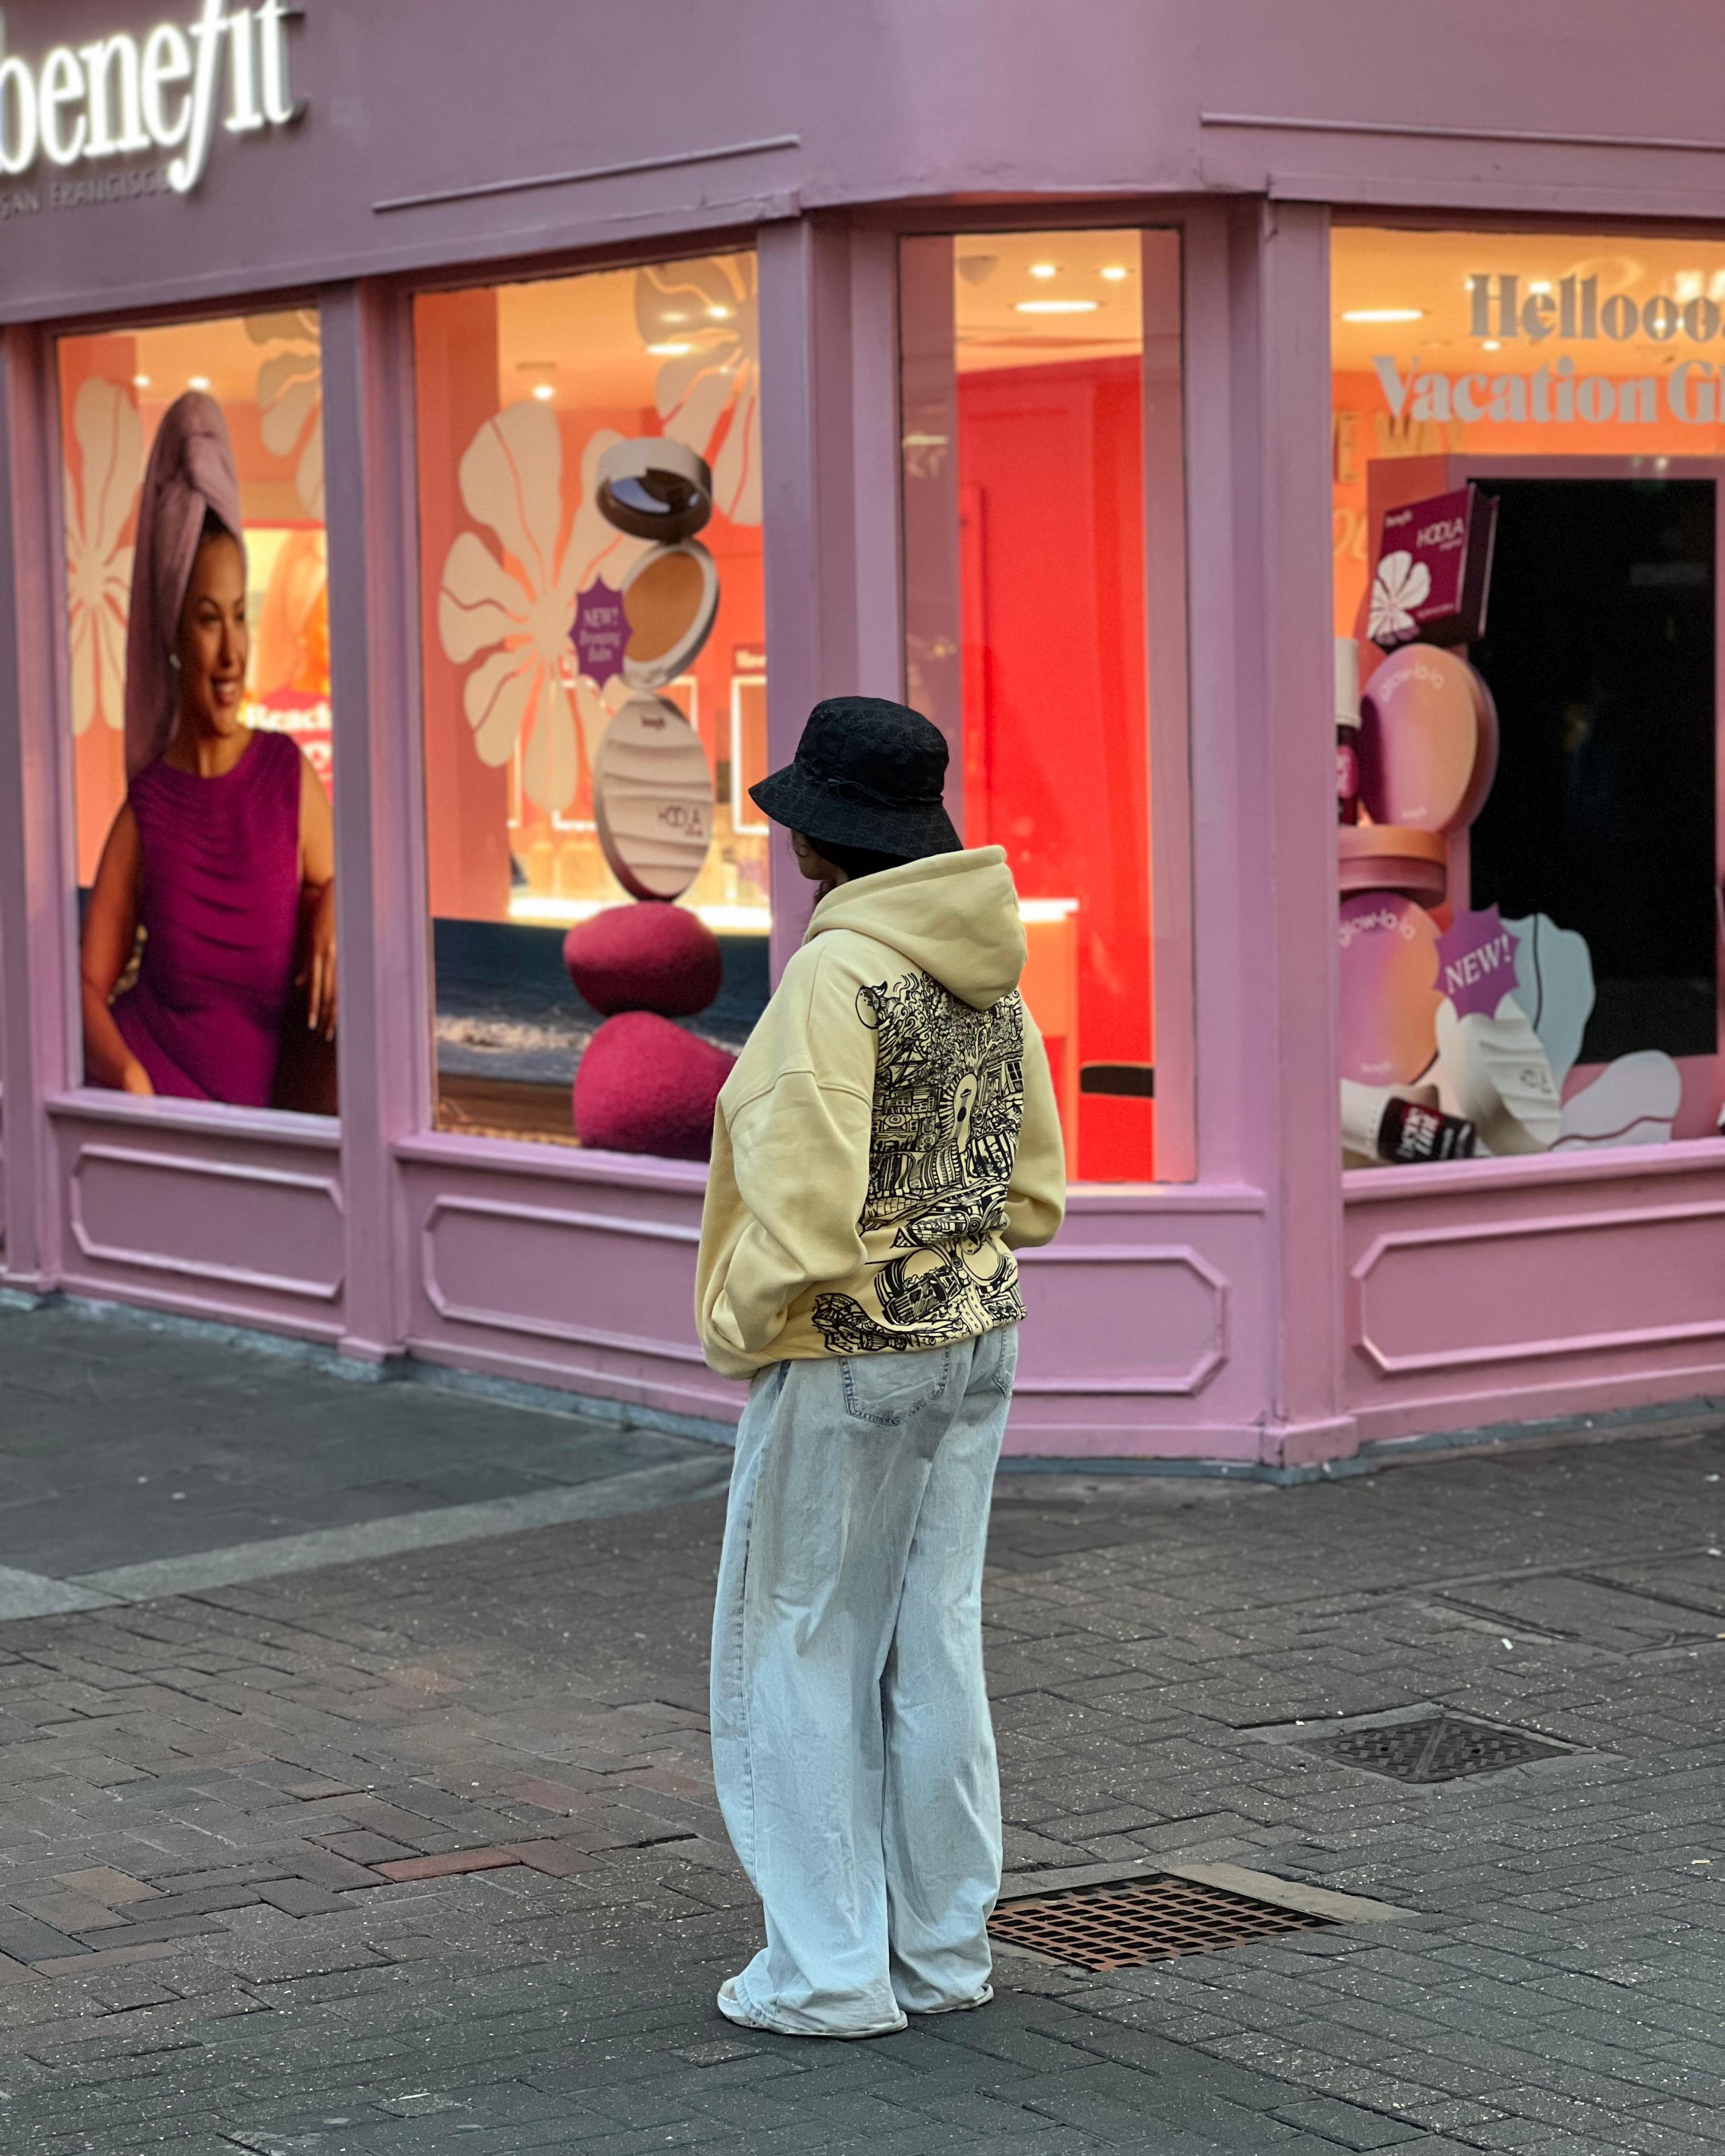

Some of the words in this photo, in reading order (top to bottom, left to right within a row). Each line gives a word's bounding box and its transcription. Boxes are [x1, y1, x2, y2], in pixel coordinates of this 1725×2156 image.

[1469, 273, 1725, 342] Hellooo
[1373, 354, 1658, 424] Vacation
[1668, 359, 1725, 424] G
[1444, 934, 1512, 995] NEW!
